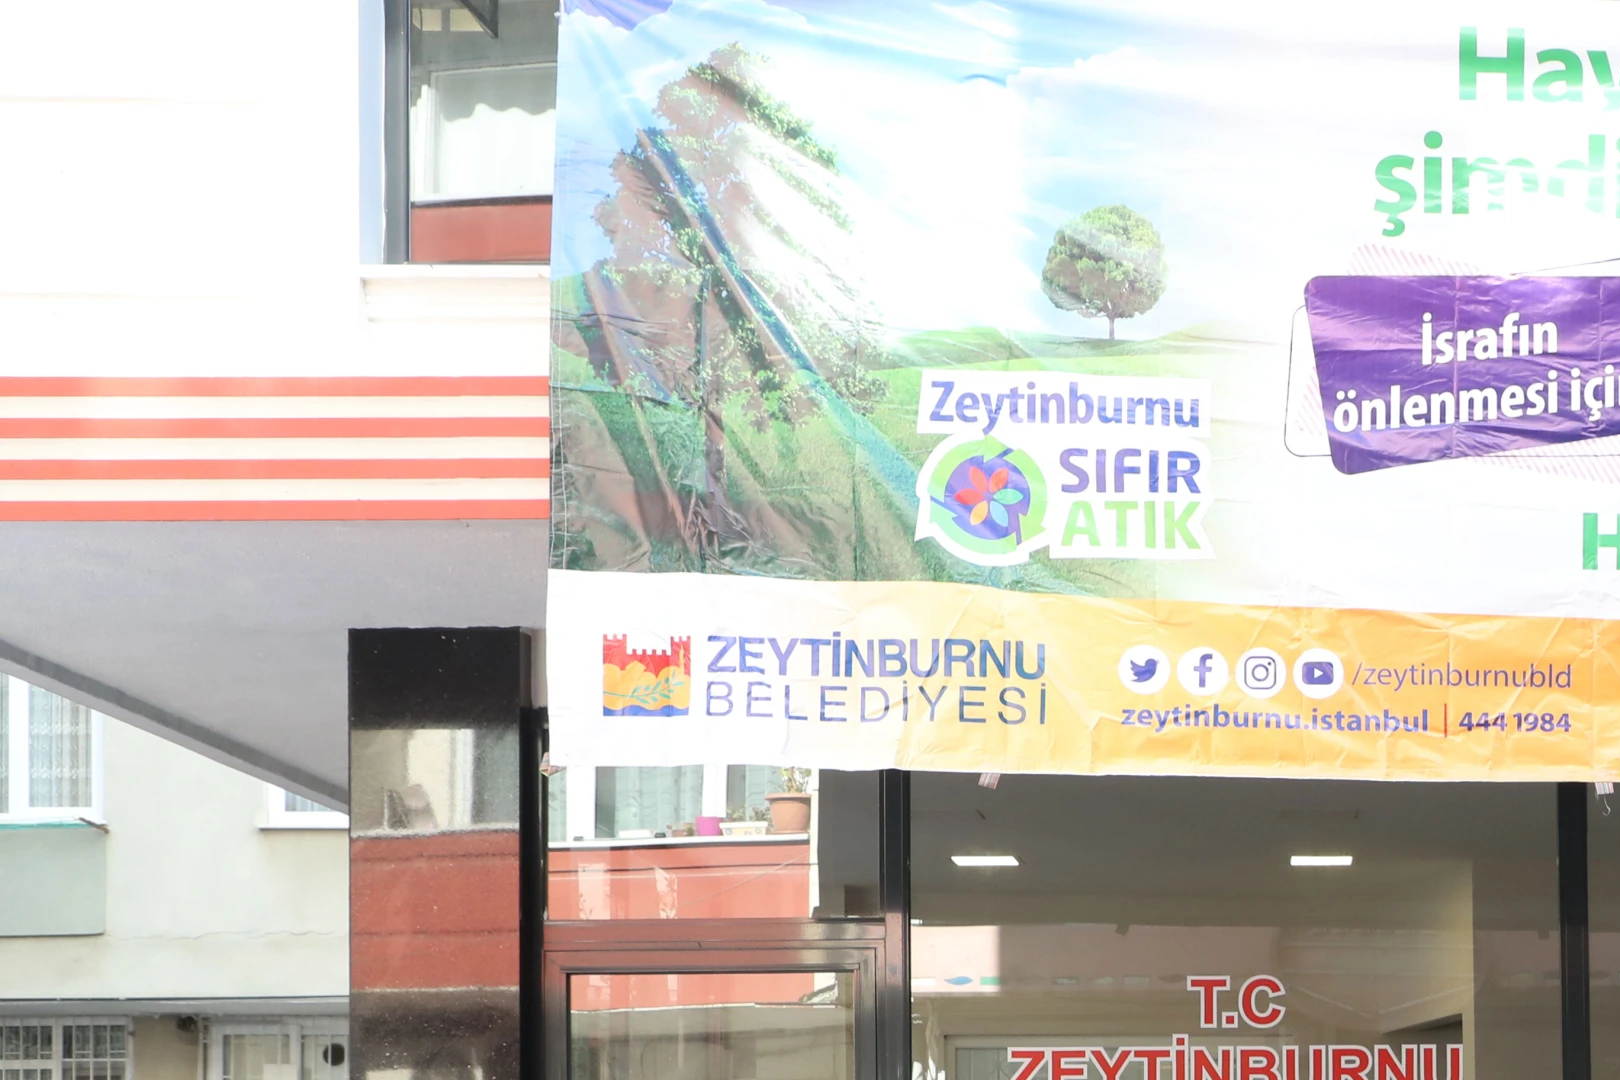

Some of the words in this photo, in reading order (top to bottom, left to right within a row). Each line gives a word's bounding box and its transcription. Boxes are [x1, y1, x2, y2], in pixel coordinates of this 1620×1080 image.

[1421, 311, 1558, 366] İsrafın
[929, 380, 1201, 436] Zeytinburnu
[1333, 369, 1558, 434] önlenmesi
[1060, 446, 1202, 496] SIFIR
[1061, 500, 1201, 551] ATIK
[705, 631, 1046, 681] ZEYTİNBURNU
[1351, 661, 1572, 694] /zeytinburnubld
[705, 680, 1048, 727] BELEDİYESİ
[1120, 703, 1429, 734] zeytinburnu.istanbul
[1458, 711, 1508, 732] 444
[1512, 711, 1572, 733] 1984
[1186, 973, 1287, 1028] T.C
